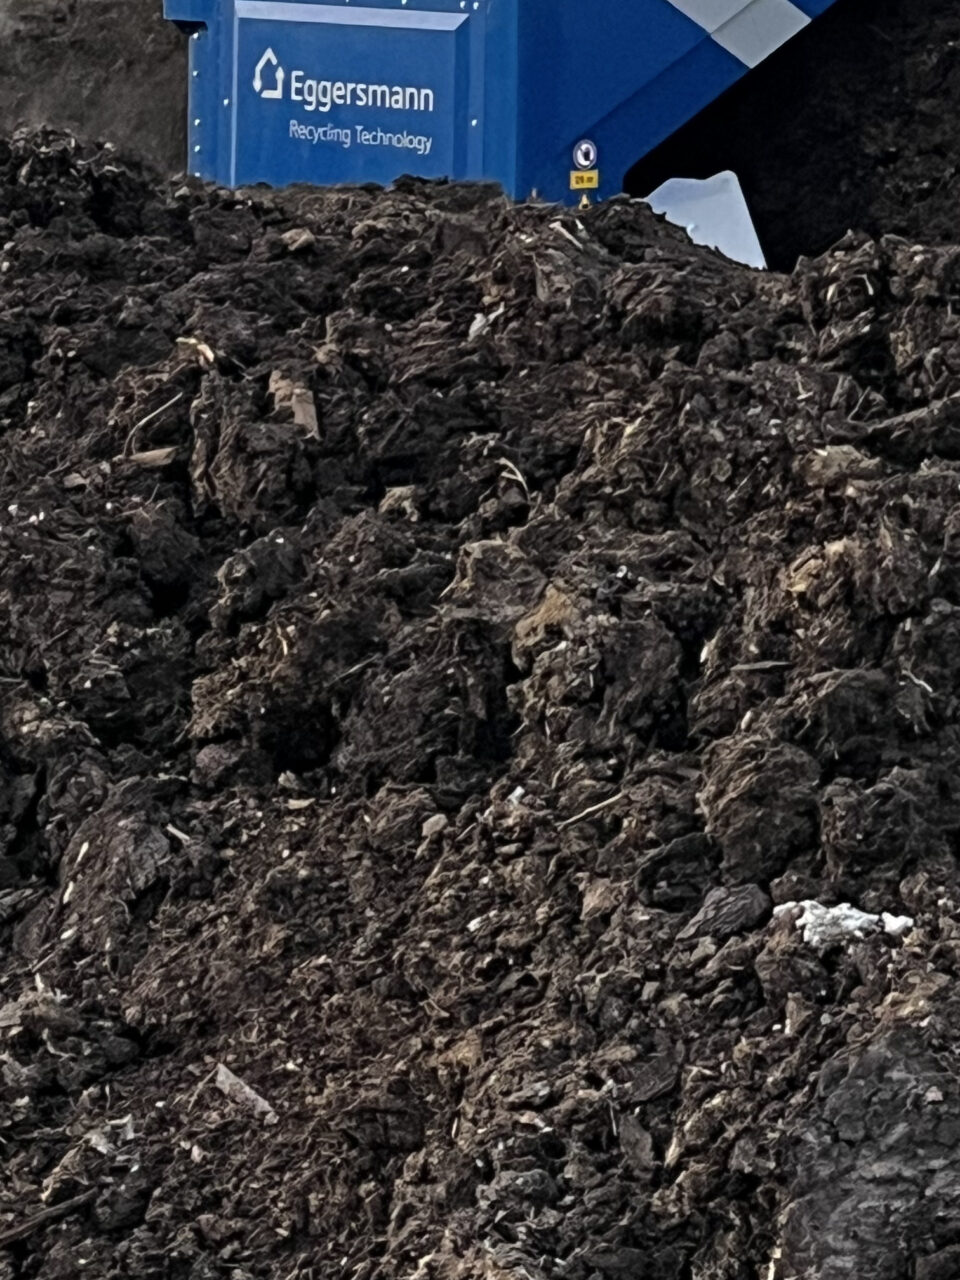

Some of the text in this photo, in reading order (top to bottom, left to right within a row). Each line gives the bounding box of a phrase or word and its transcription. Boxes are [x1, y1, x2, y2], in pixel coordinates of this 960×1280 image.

[290, 70, 434, 112] Eggersmann
[289, 119, 432, 155] Recycling Technology
